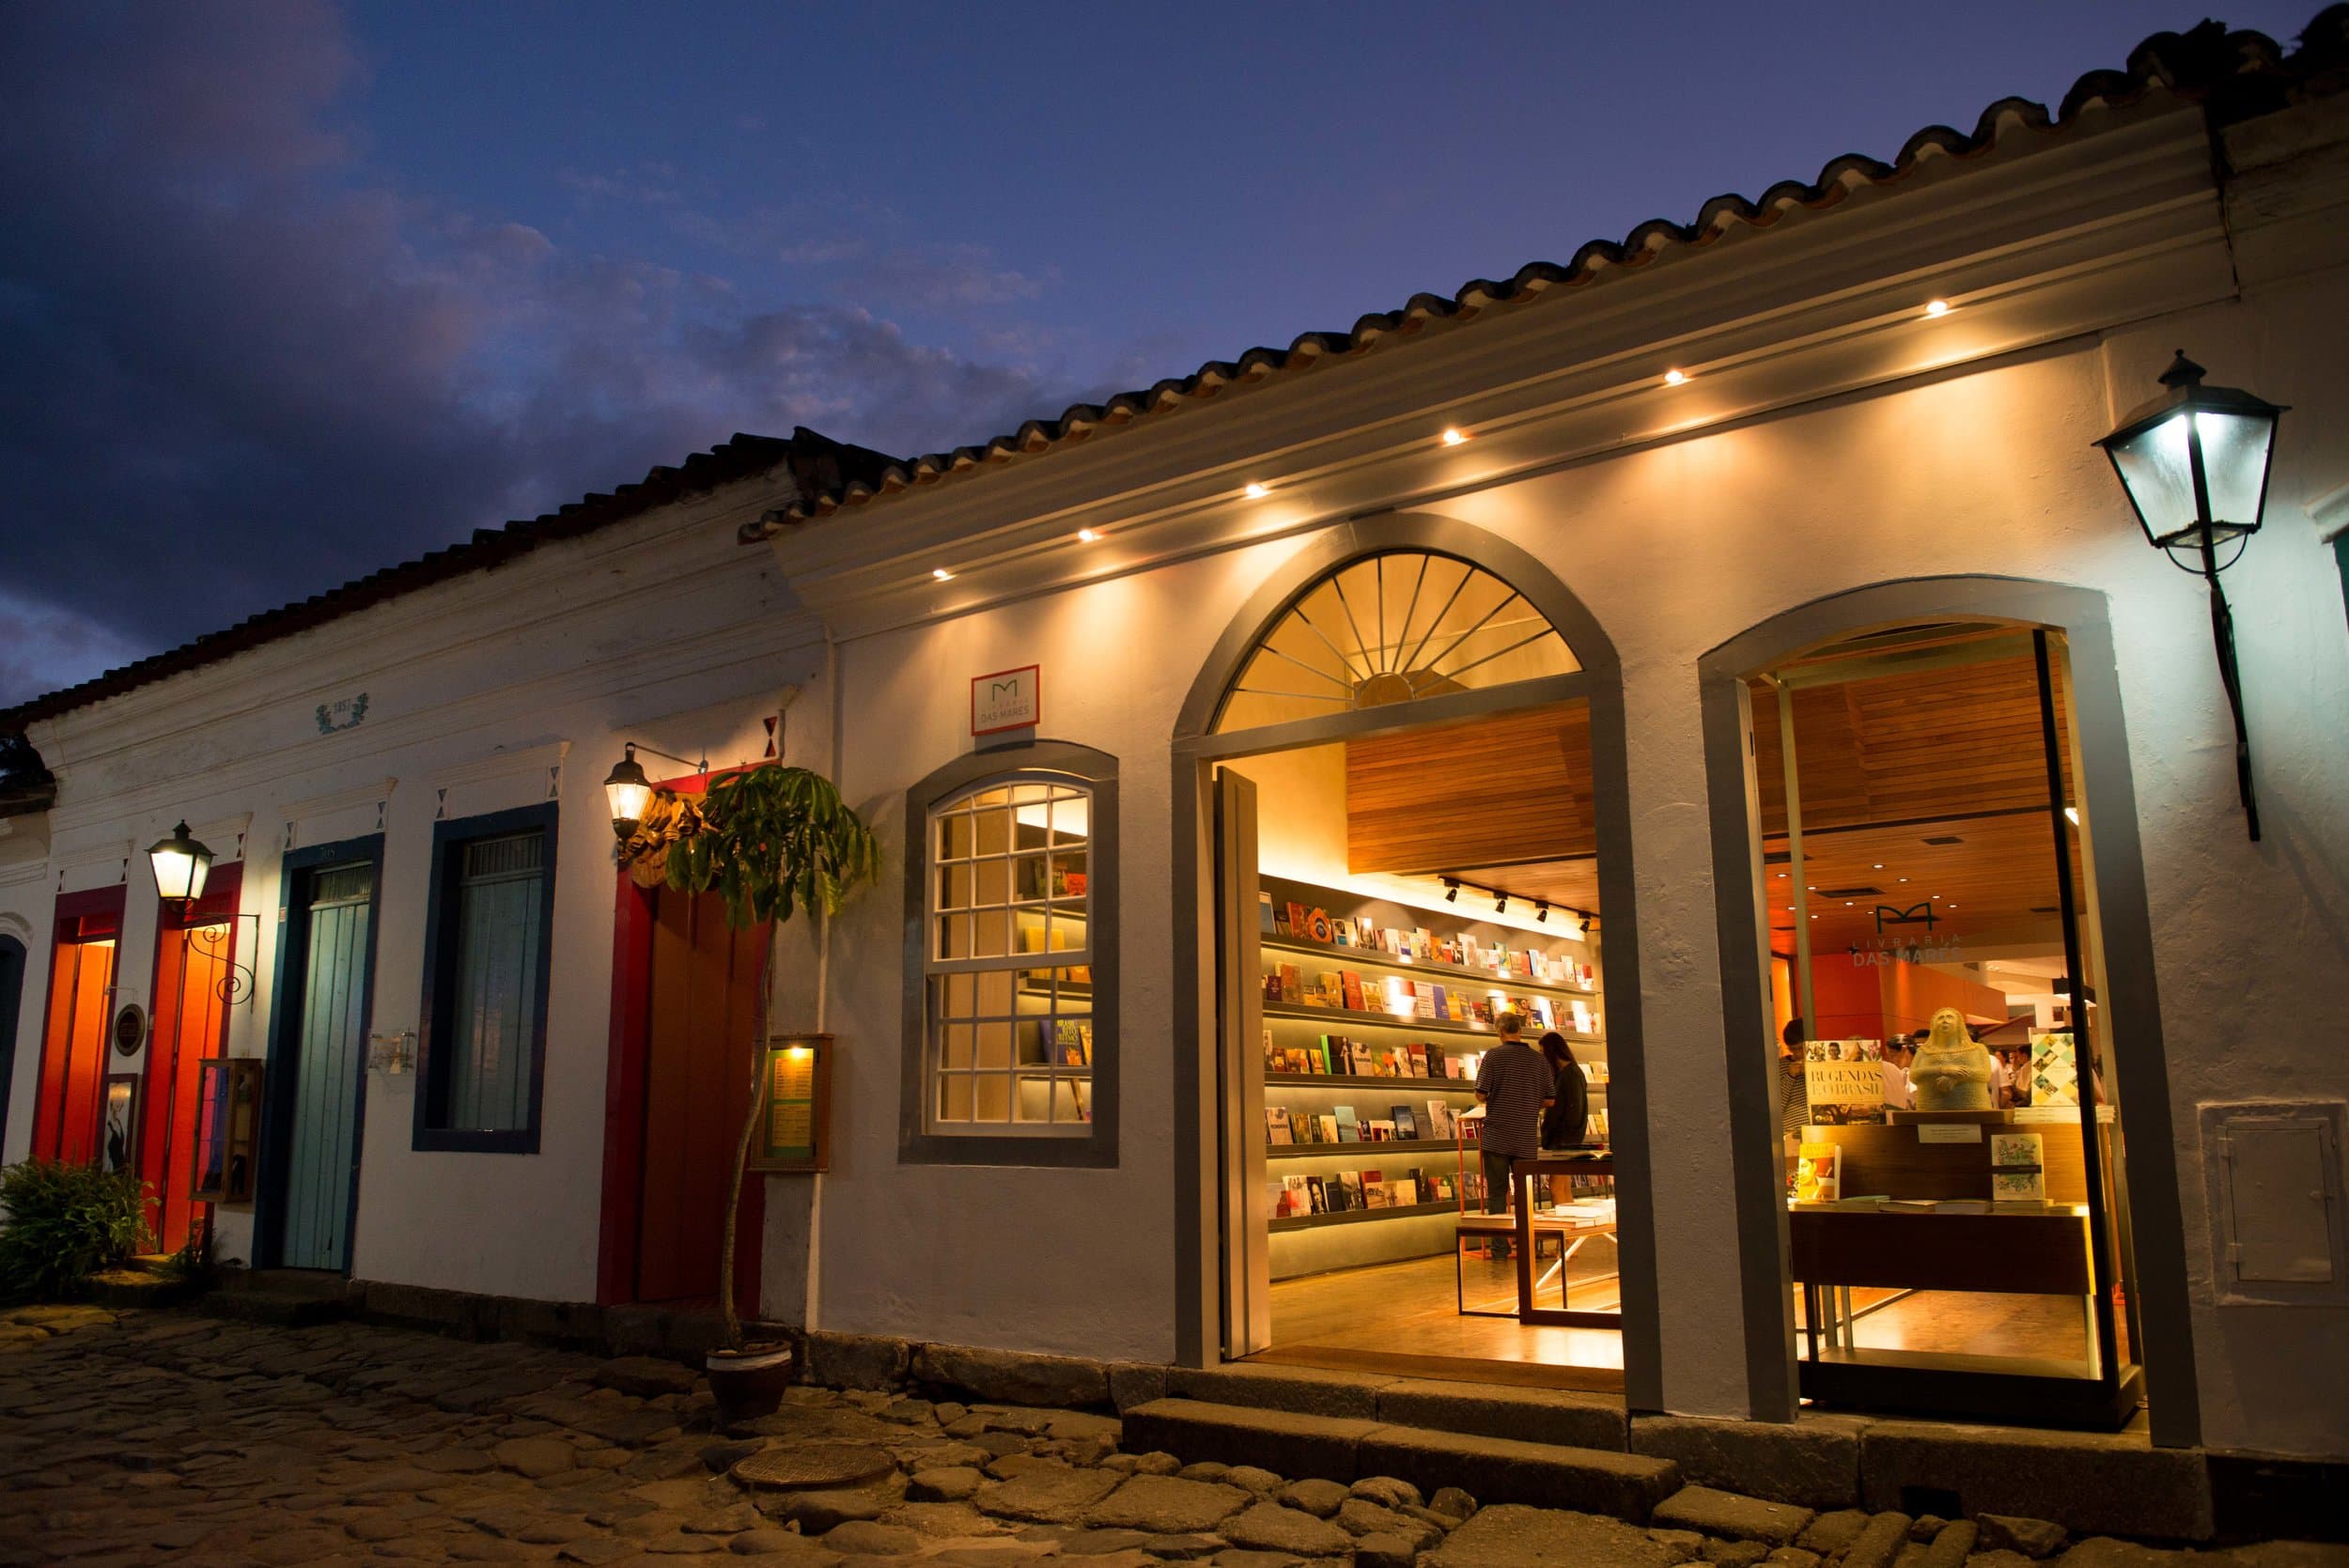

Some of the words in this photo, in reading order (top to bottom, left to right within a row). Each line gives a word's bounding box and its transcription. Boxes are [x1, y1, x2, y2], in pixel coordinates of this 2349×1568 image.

[1852, 934, 1961, 949] LIVRARIA
[1853, 951, 1889, 968] DAS
[1811, 1070, 1882, 1081] RUGENDAS
[1835, 1083, 1879, 1095] BRASIL
